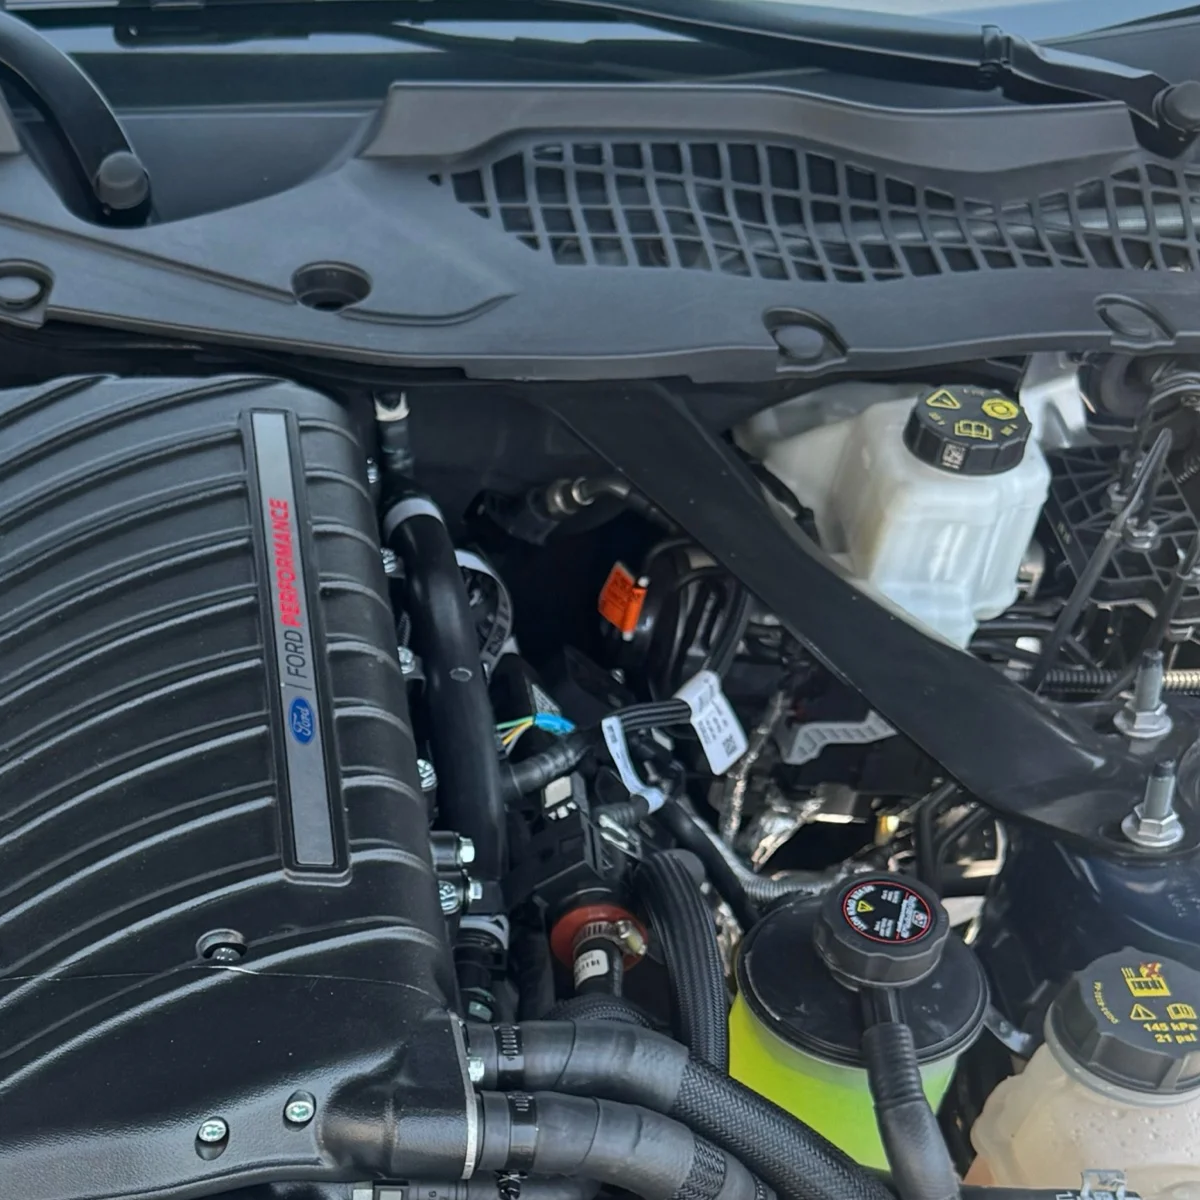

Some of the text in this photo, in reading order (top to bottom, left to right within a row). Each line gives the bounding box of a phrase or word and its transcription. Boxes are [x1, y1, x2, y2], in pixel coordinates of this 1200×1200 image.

[269, 497, 312, 738] Ford FORD PERFORMANCE
[1143, 1022, 1198, 1032] 145 kPa
[1154, 1032, 1197, 1044] 21 psi
